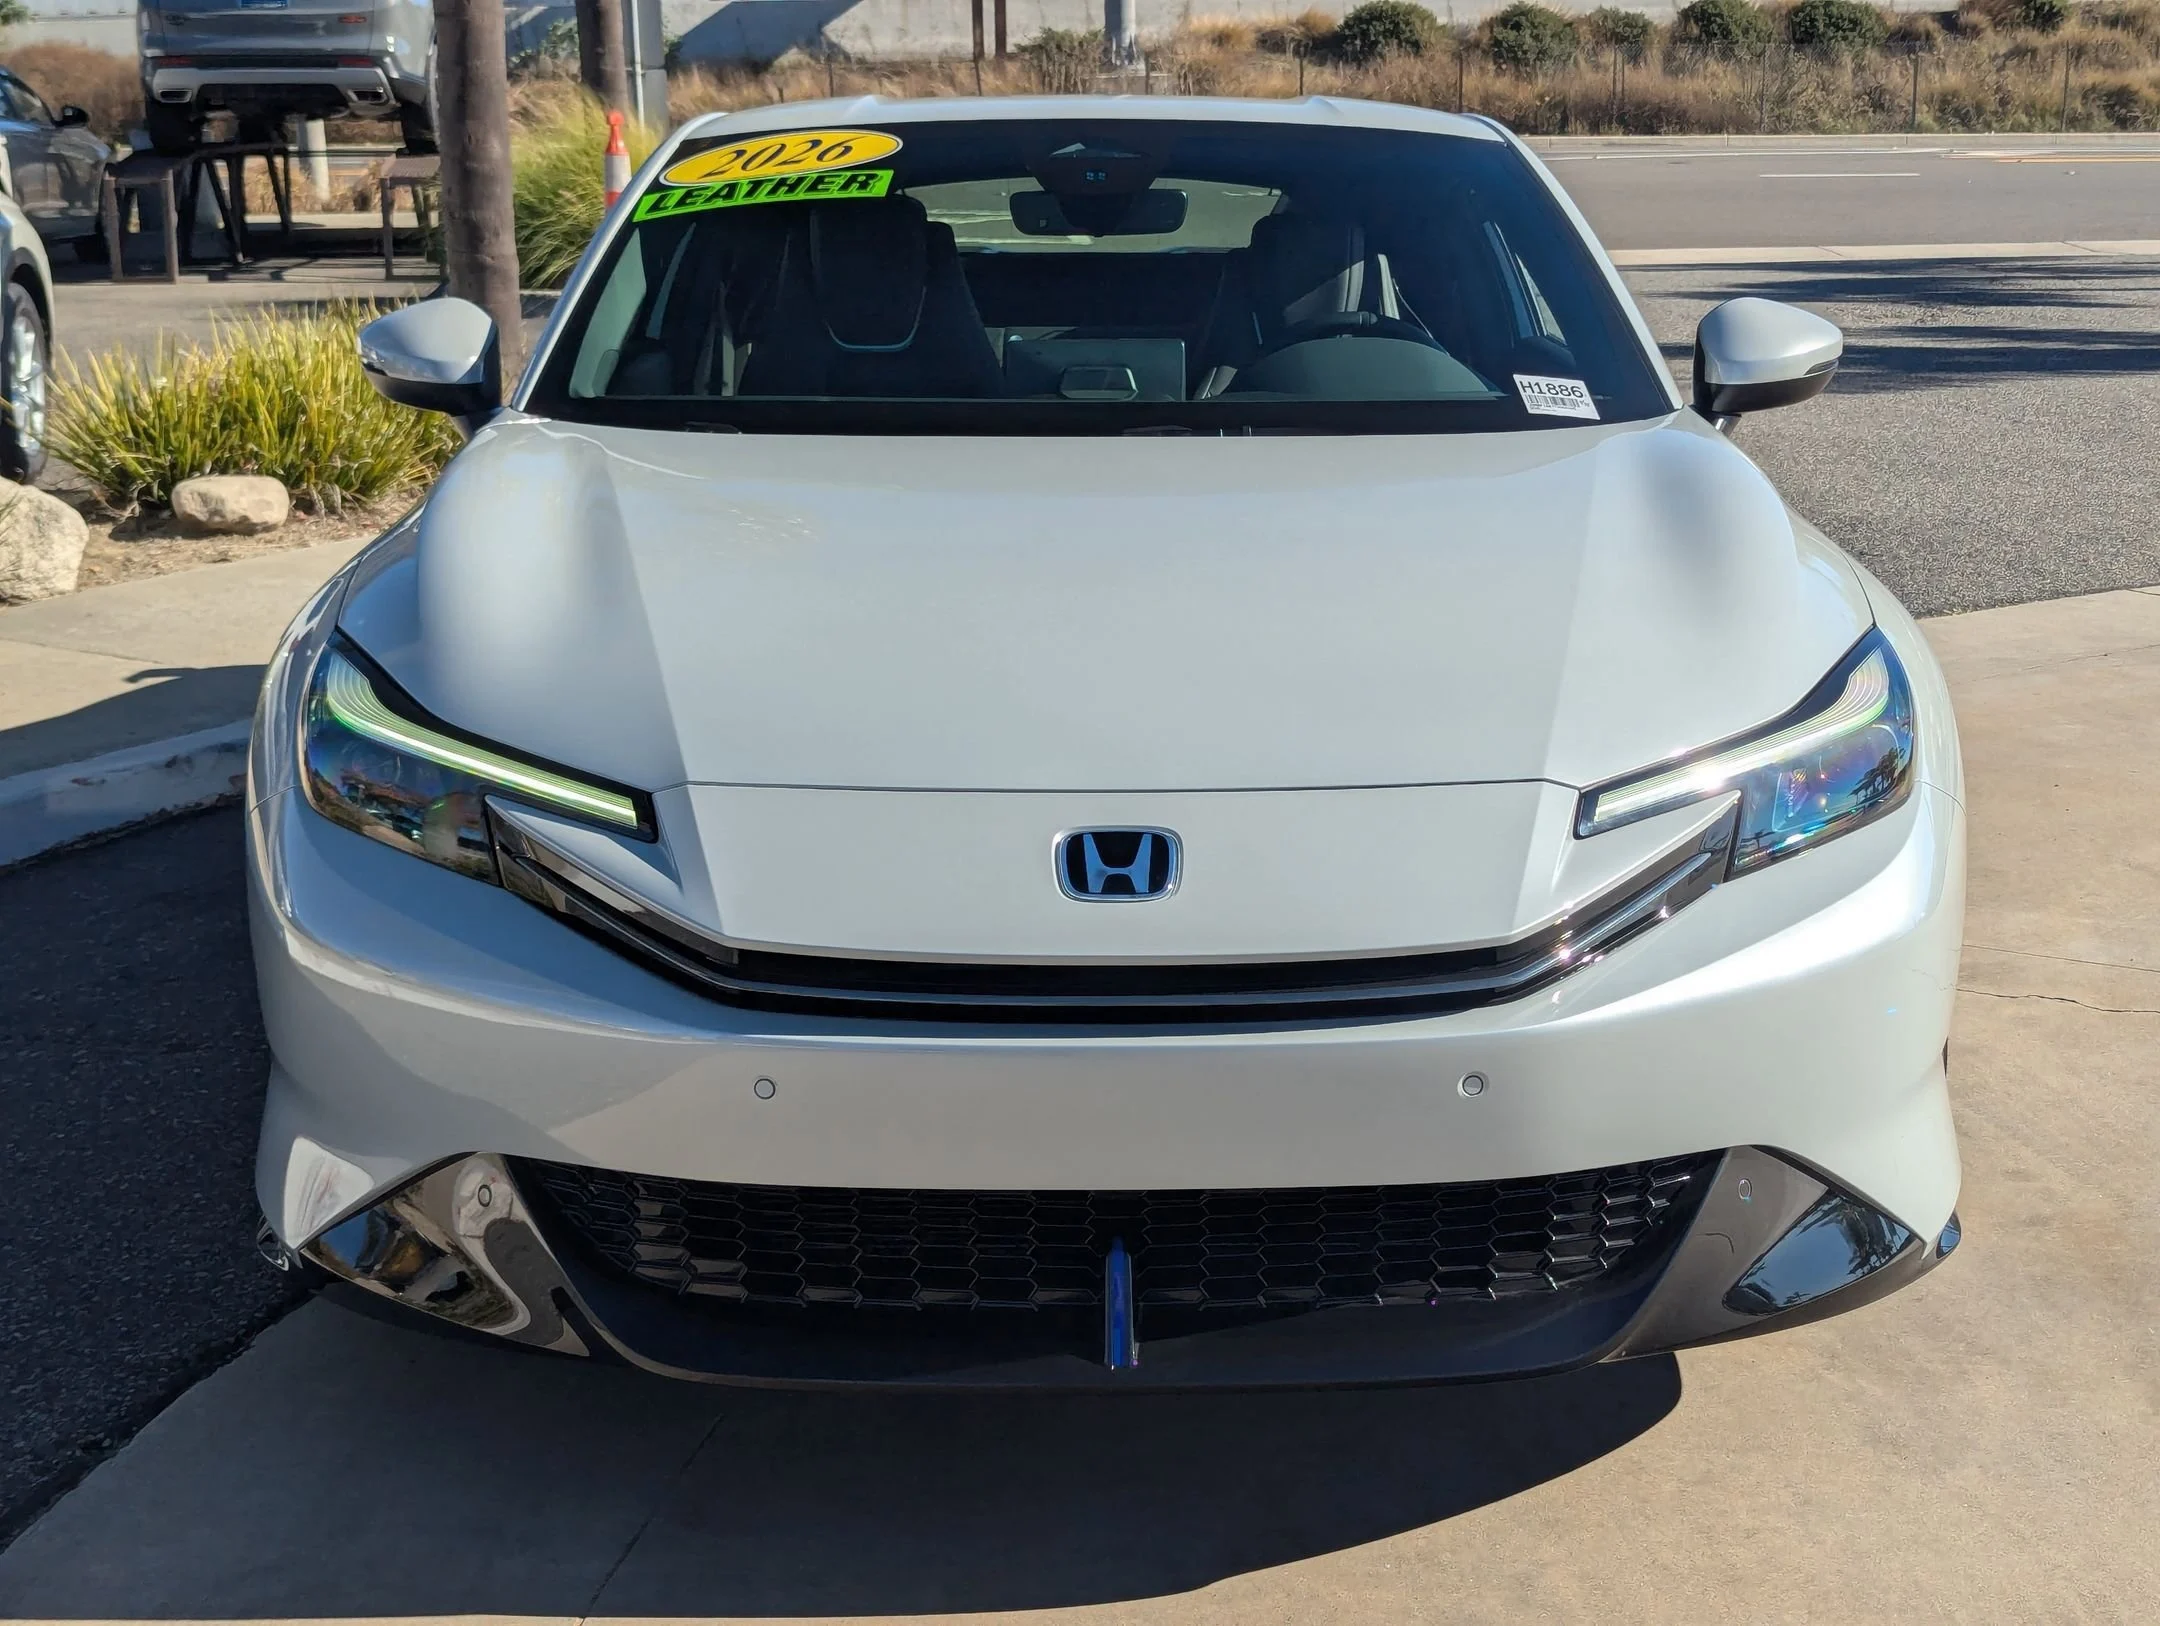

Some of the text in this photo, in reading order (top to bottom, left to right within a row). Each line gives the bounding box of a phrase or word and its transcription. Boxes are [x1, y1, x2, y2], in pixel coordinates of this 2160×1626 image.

[697, 136, 865, 180] 2026
[645, 172, 883, 215] LEATHER
[1519, 380, 1584, 398] H1886
